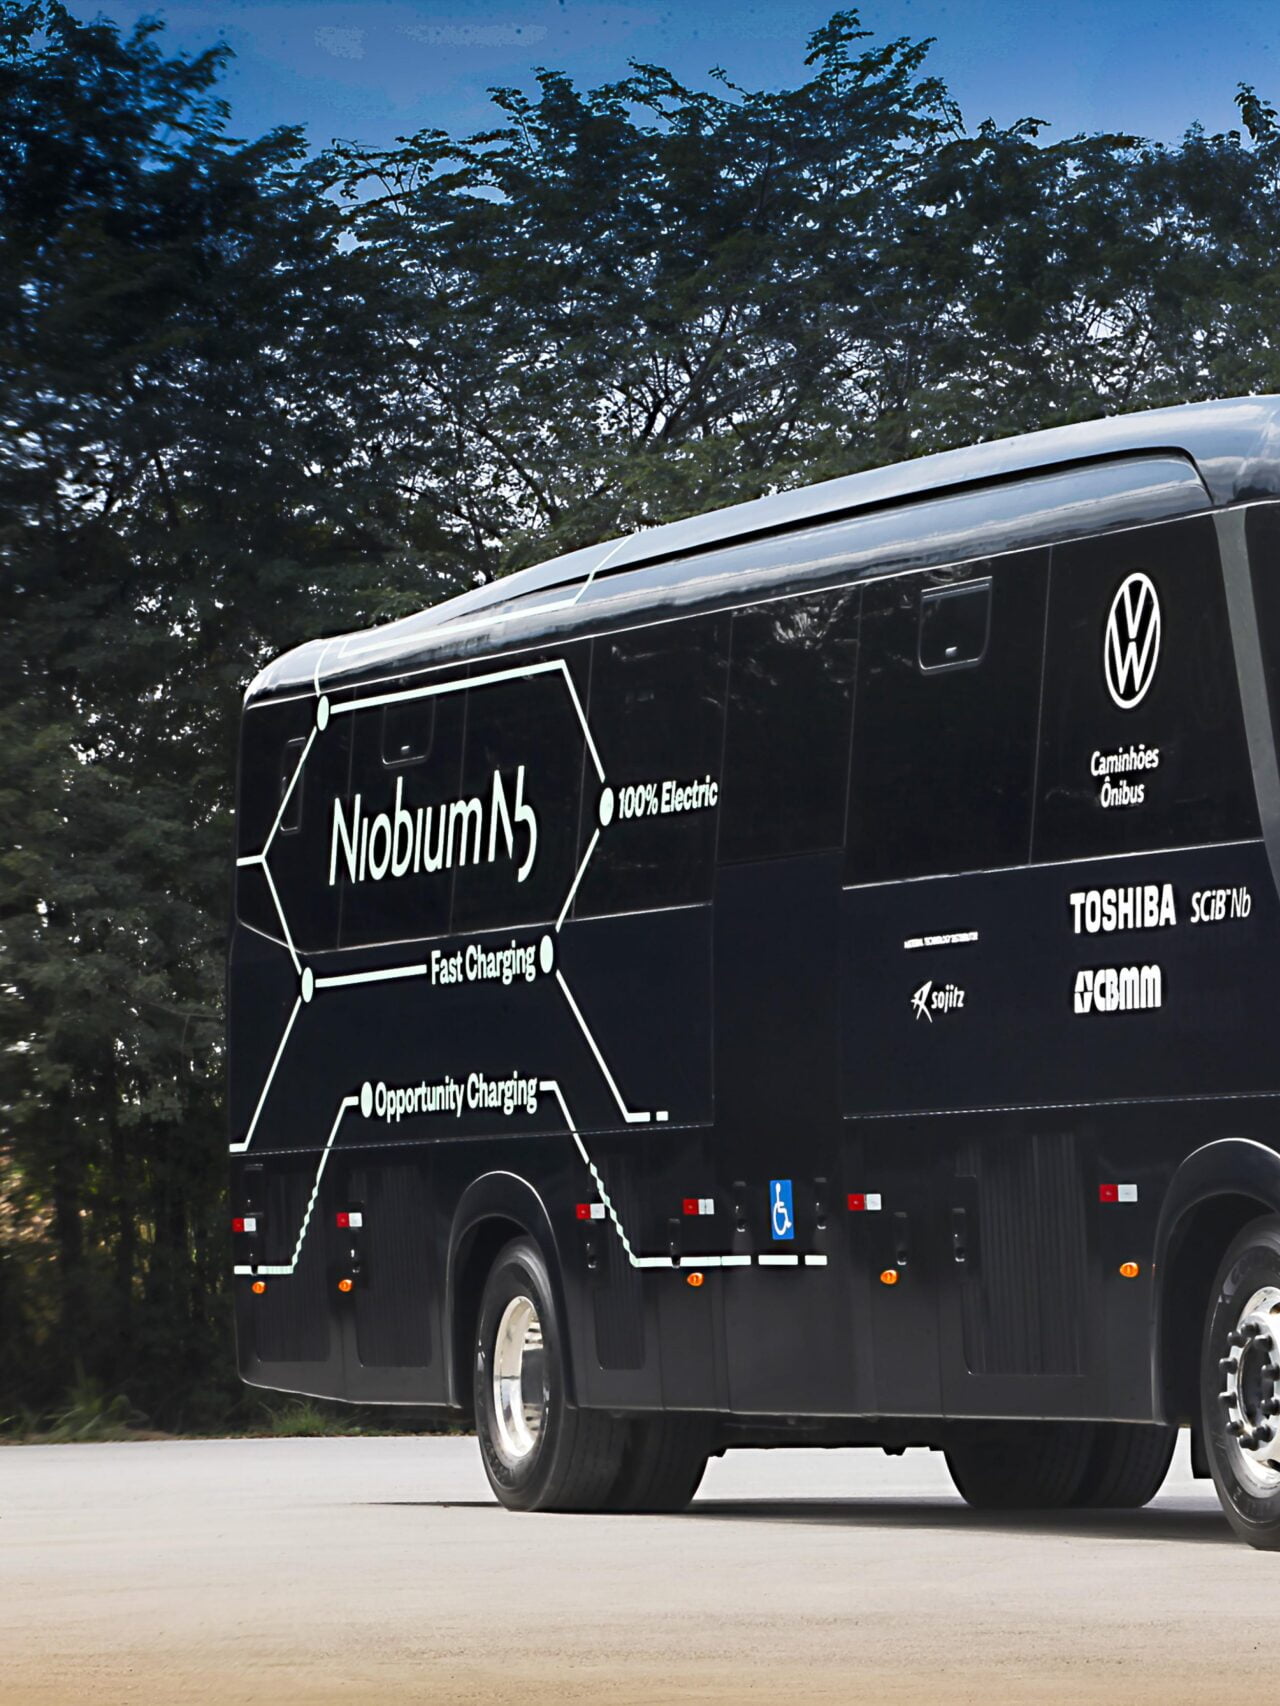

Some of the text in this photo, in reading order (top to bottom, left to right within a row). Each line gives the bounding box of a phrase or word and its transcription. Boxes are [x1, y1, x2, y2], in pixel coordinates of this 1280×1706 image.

[1090, 744, 1160, 776] Caminhões
[618, 774, 719, 820] 100% Electric
[1100, 775, 1146, 808] Ônibus
[1069, 883, 1177, 934] TOSHIBA
[431, 939, 537, 986] Fast Charging
[930, 984, 965, 1013] sojitz
[1093, 964, 1162, 1012] CBMM
[374, 1070, 538, 1124] Opportunity Charging
